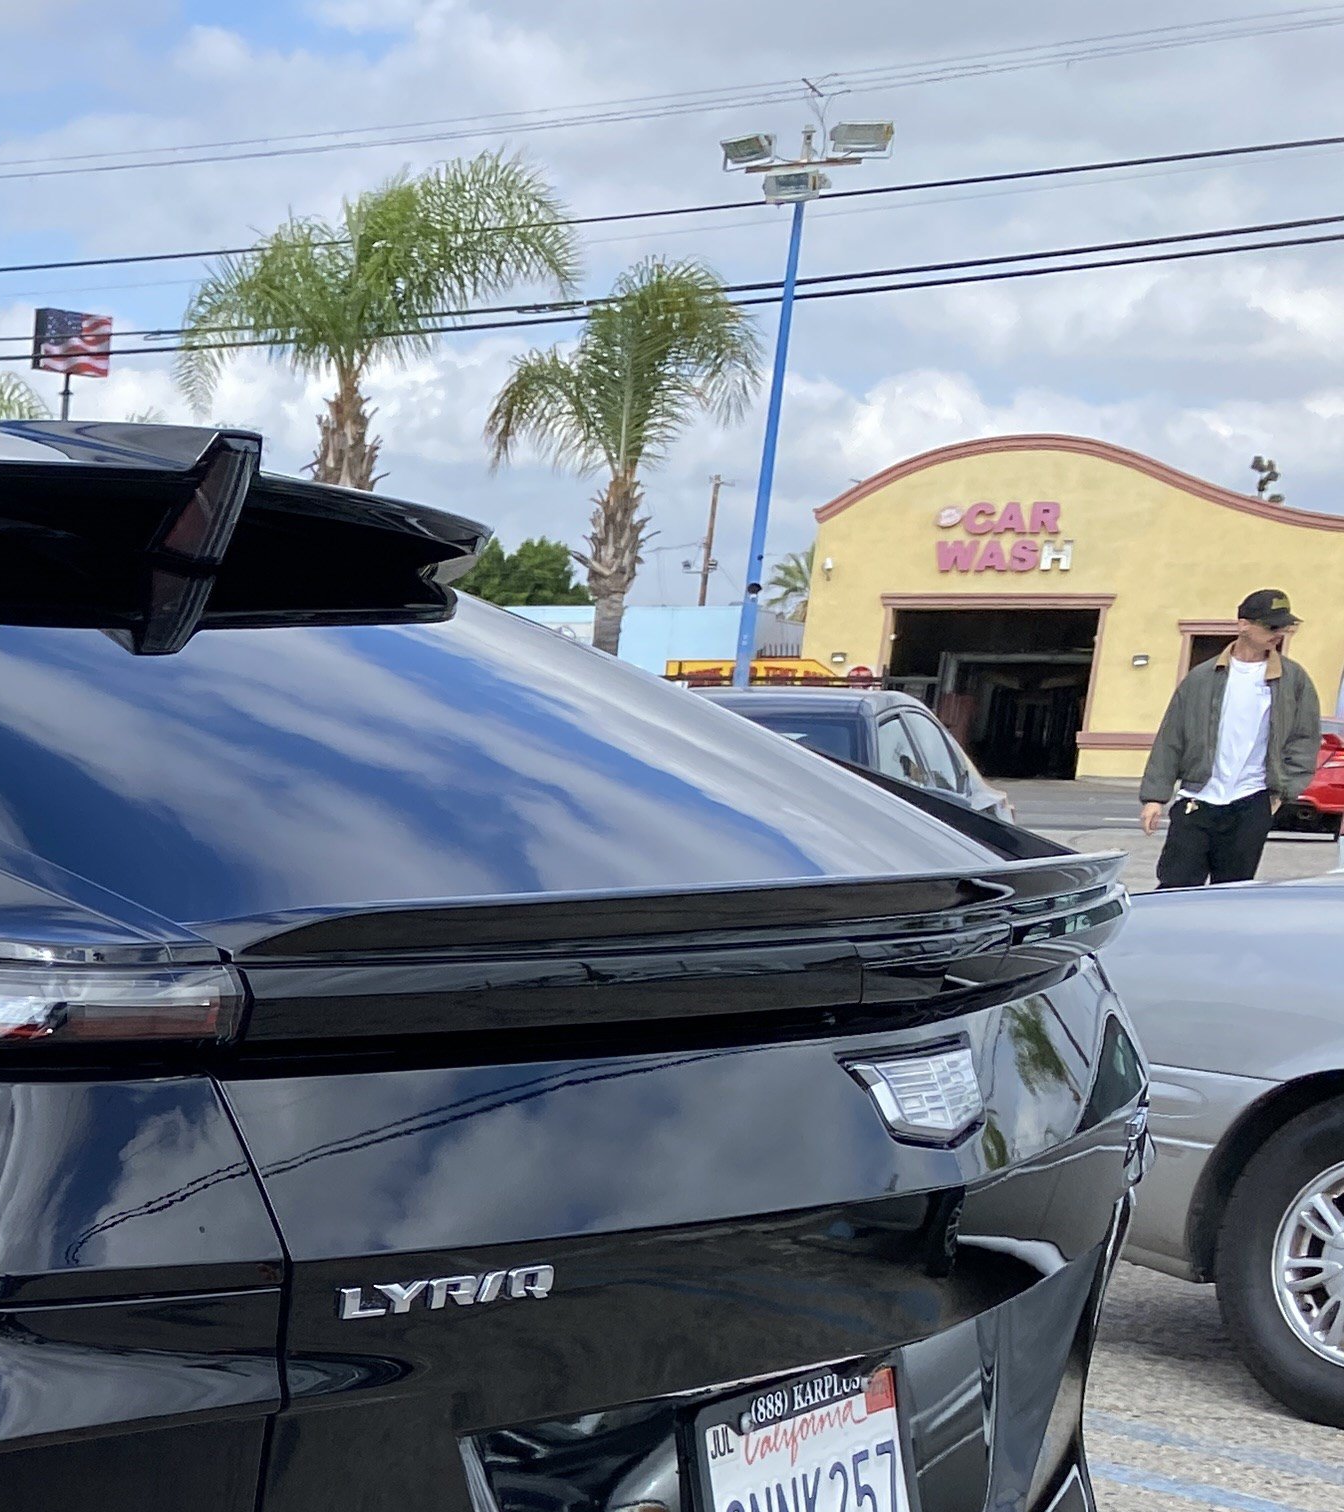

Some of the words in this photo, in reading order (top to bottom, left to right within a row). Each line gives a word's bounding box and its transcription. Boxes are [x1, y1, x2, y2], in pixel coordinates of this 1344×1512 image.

[964, 501, 1061, 535] CAR
[936, 540, 1074, 573] WASH
[339, 1264, 555, 1320] LYRIQ
[750, 1389, 789, 1424] (888)
[792, 1372, 862, 1412] KARPLUS
[710, 1426, 734, 1460] JUL
[744, 1399, 868, 1467] California
